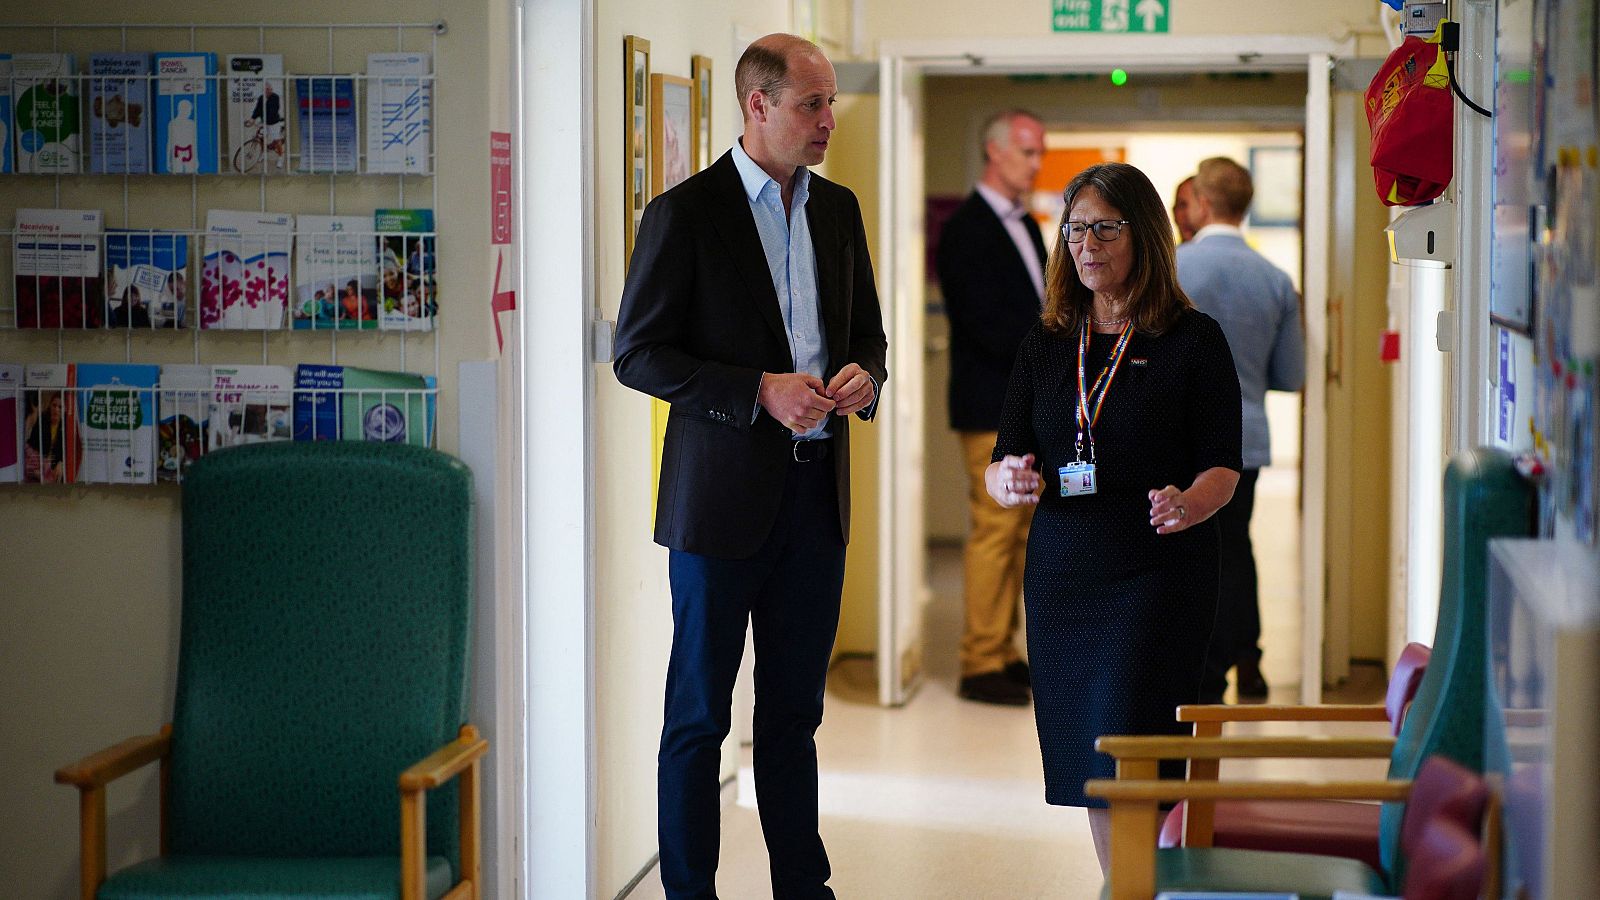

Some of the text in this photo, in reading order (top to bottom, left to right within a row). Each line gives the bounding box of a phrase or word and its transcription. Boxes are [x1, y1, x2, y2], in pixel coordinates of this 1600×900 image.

[93, 58, 121, 66] Babies
[94, 67, 136, 75] suffocate
[20, 223, 54, 232] Receiving
[299, 369, 312, 377] We
[313, 370, 326, 378] will
[299, 378, 316, 386] with
[317, 380, 331, 388] you
[93, 396, 139, 405] HELP WITH
[90, 404, 105, 413] THE
[108, 405, 129, 414] COST
[91, 413, 137, 425] CANCER
